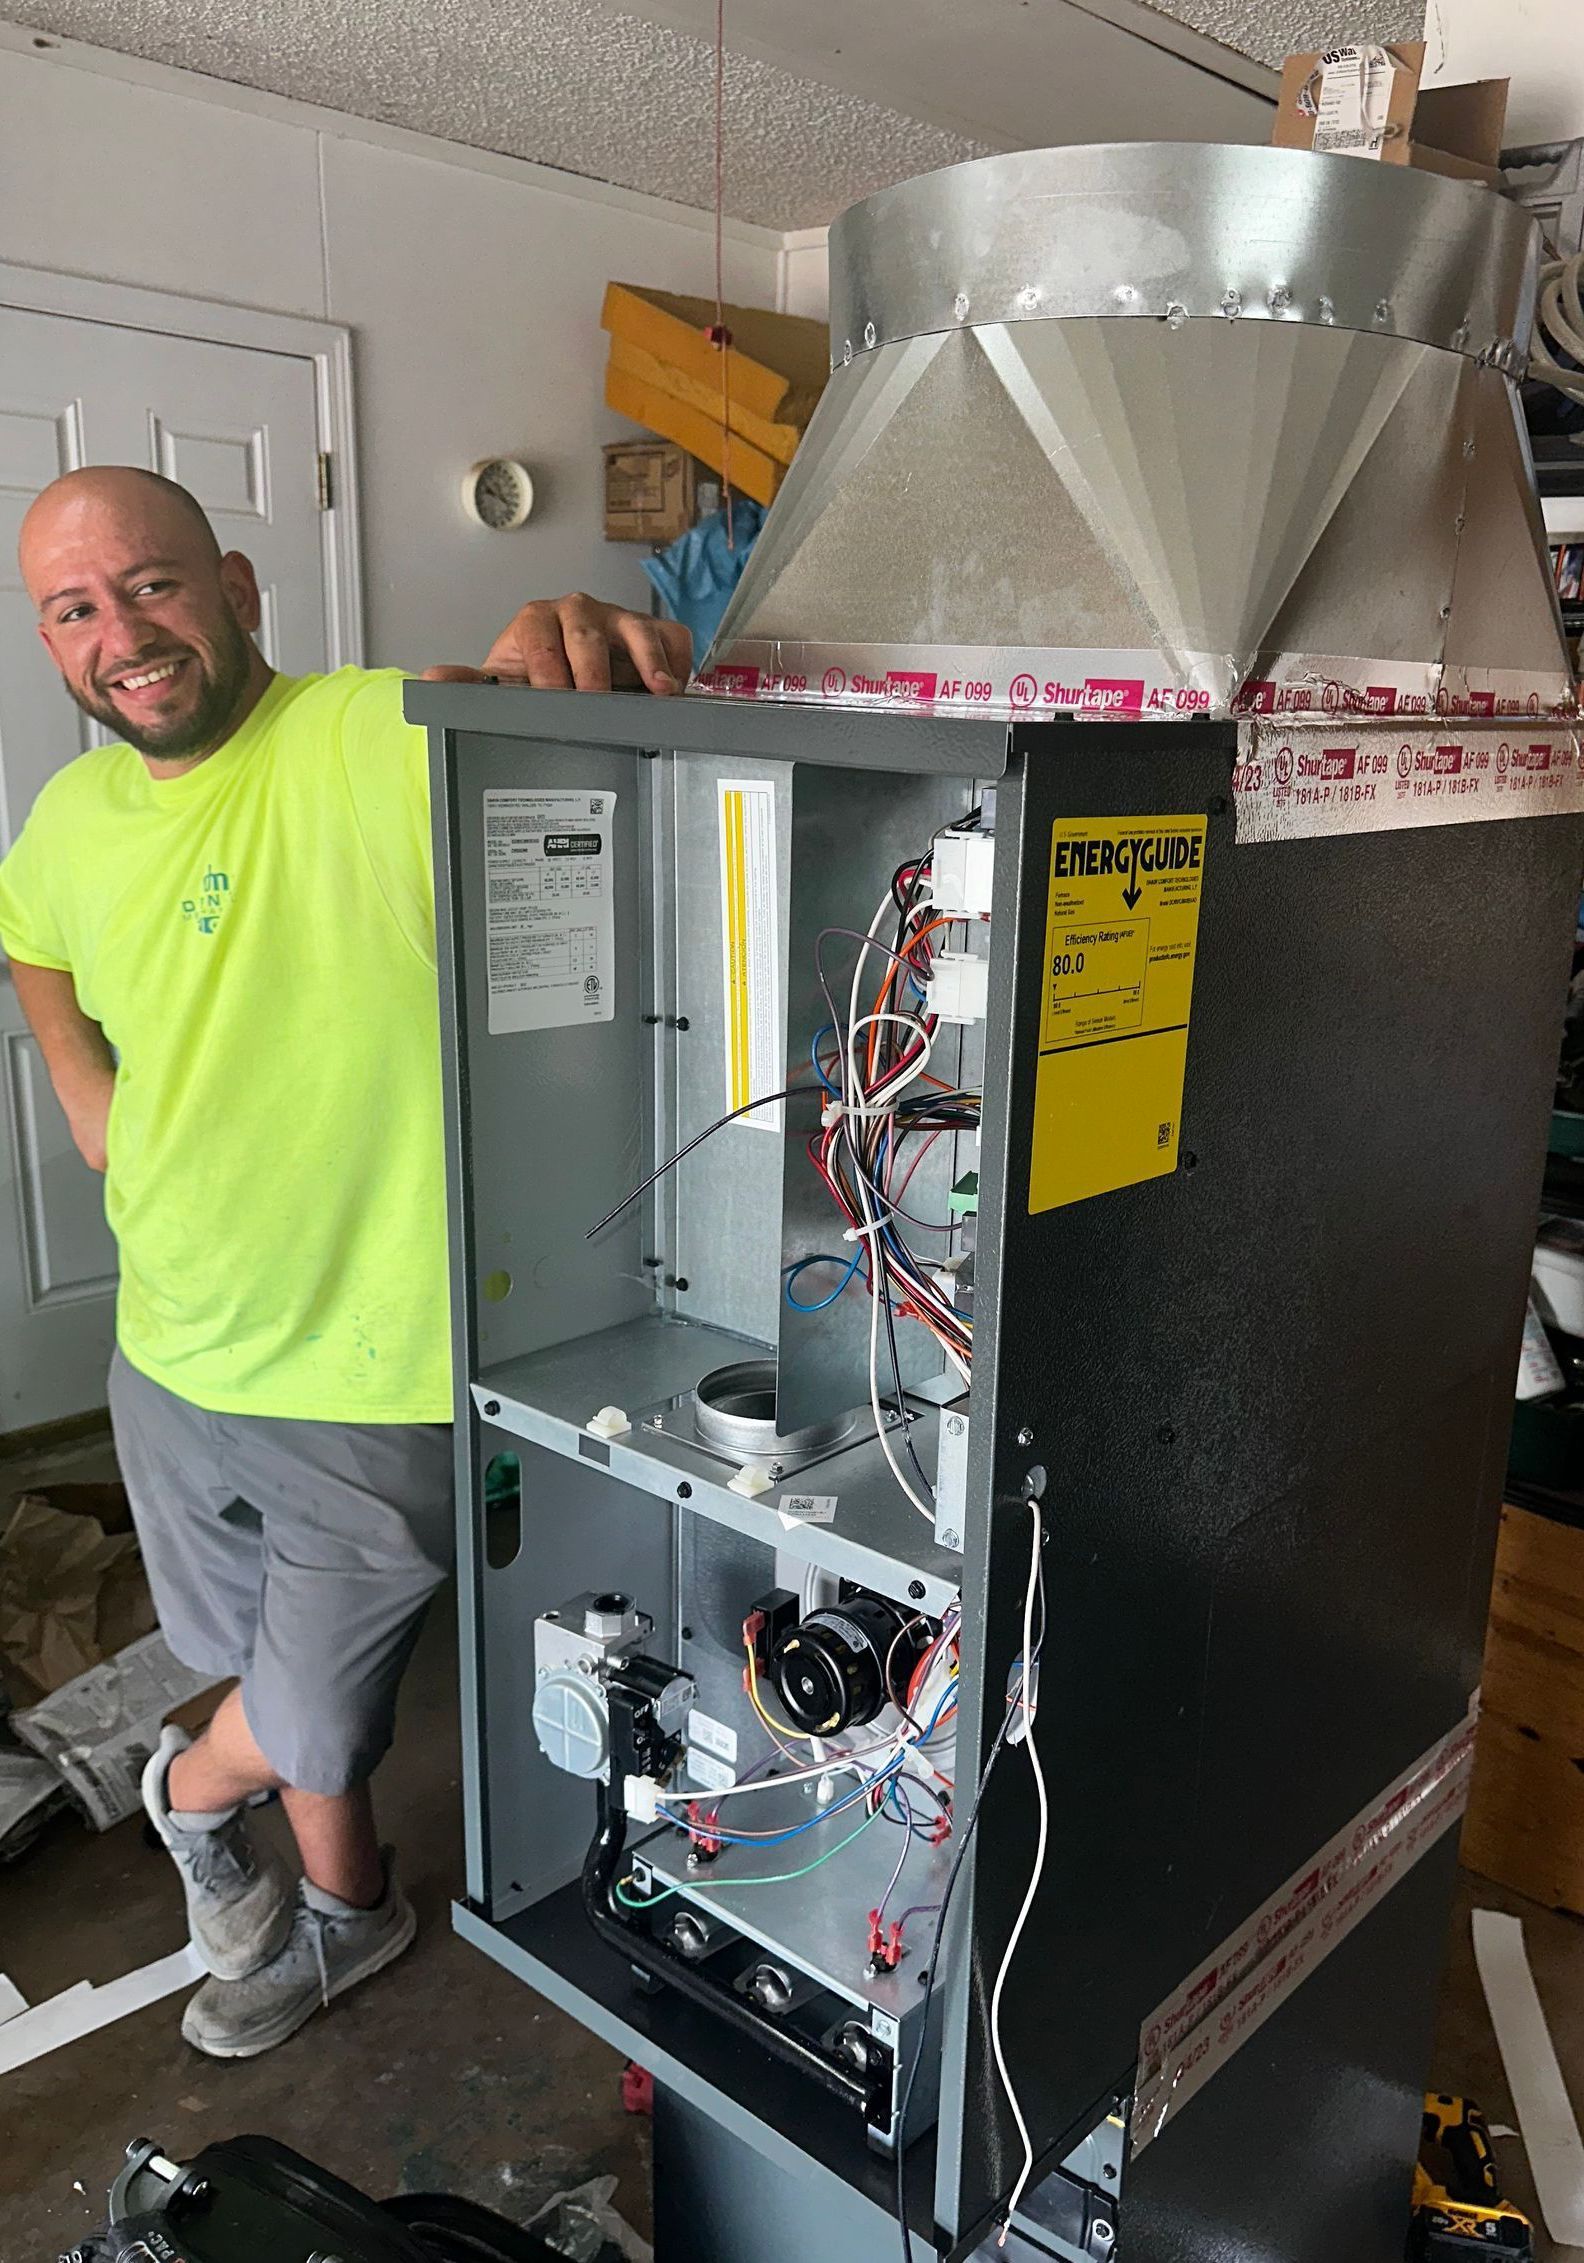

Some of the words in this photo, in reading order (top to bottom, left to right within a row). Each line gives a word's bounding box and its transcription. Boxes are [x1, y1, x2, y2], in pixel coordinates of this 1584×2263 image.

[1322, 50, 1340, 64] US
[761, 674, 781, 691] AF
[783, 675, 806, 692] 099
[851, 675, 920, 697] Shurtape
[940, 680, 960, 699] AF
[965, 681, 992, 701] 099
[1043, 681, 1124, 708] Shurtape
[1176, 689, 1210, 710] 099
[1276, 690, 1291, 711] AF
[1294, 690, 1312, 711] 099
[1411, 695, 1427, 712] 099
[1297, 753, 1346, 779] Shurtape
[1357, 756, 1370, 775] AF
[1371, 755, 1388, 774] 099
[1415, 750, 1454, 774] Shurtape
[1463, 751, 1475, 770] AF
[1476, 752, 1489, 769] 099
[1296, 786, 1330, 805] 181A-P
[1340, 784, 1376, 802] 181B-FX
[1413, 780, 1441, 797] 181A-P
[1054, 836, 1202, 878] ENERGYGUIDE
[1065, 933, 1097, 947] Efficiency
[1098, 931, 1119, 943] Rating
[1053, 952, 1085, 976] 80.0
